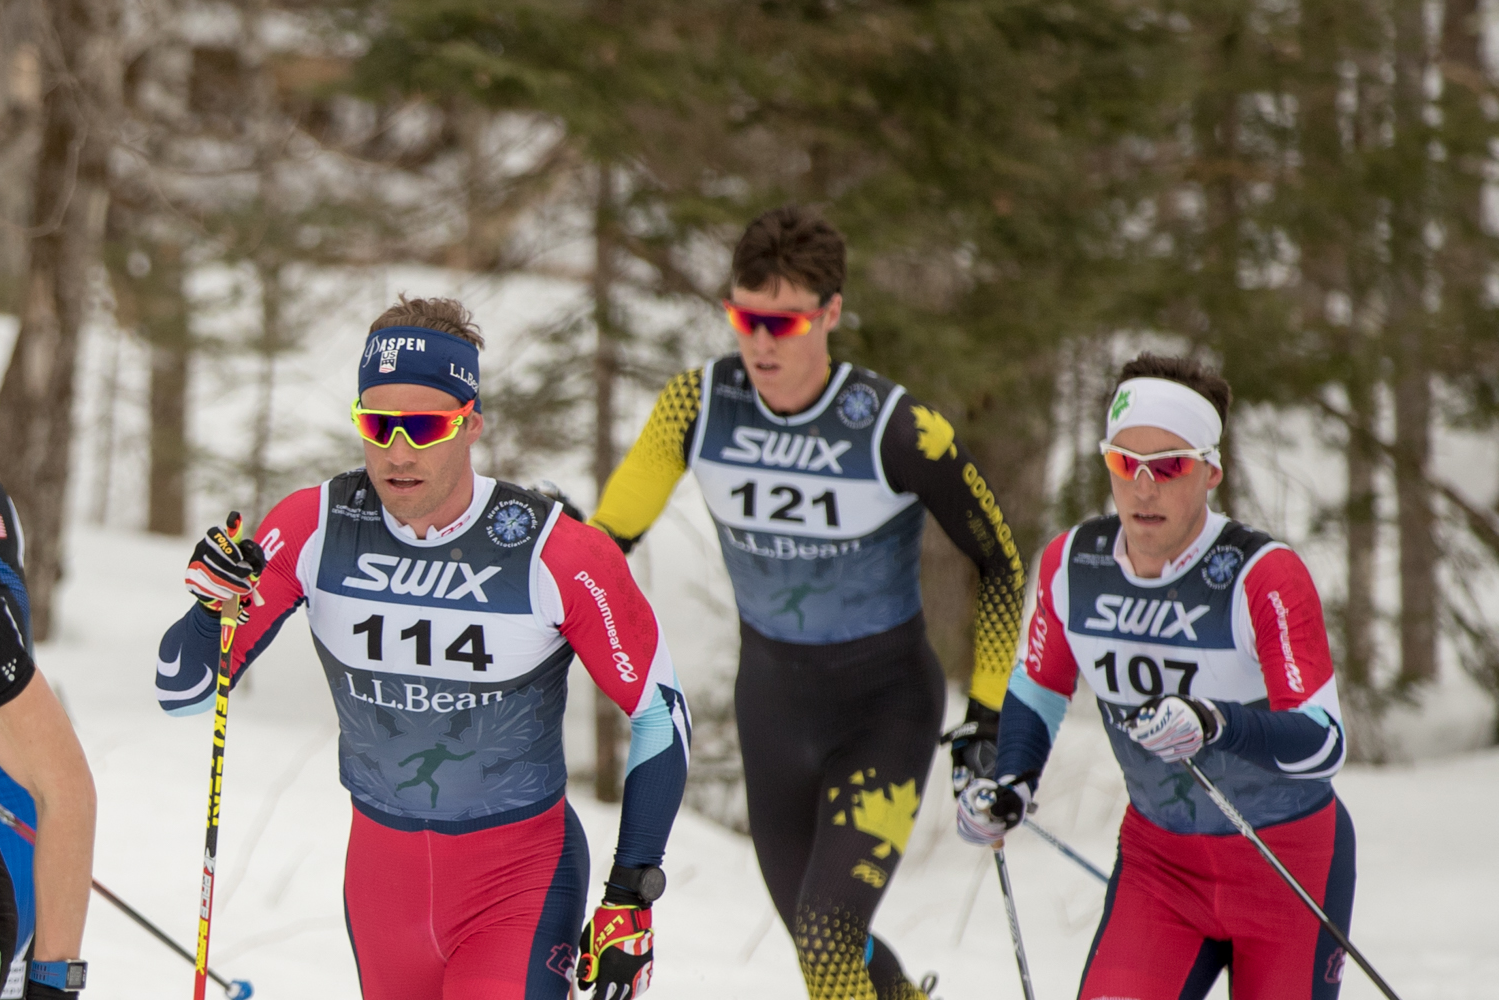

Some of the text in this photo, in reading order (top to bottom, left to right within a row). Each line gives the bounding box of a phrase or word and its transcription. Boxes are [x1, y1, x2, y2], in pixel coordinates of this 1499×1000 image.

[379, 338, 426, 352] ASPEN
[450, 363, 479, 393] L.L.Be
[721, 426, 852, 474] SWIX
[487, 499, 537, 529] New England Nordic
[731, 480, 839, 527] 121
[486, 525, 531, 548] Ski Association
[342, 553, 502, 603] SWIX
[574, 570, 623, 650] podiumwear
[1084, 594, 1211, 640] SWIX
[353, 614, 493, 672] 114
[345, 671, 503, 713] L.L.Bean
[1095, 651, 1198, 696] 107
